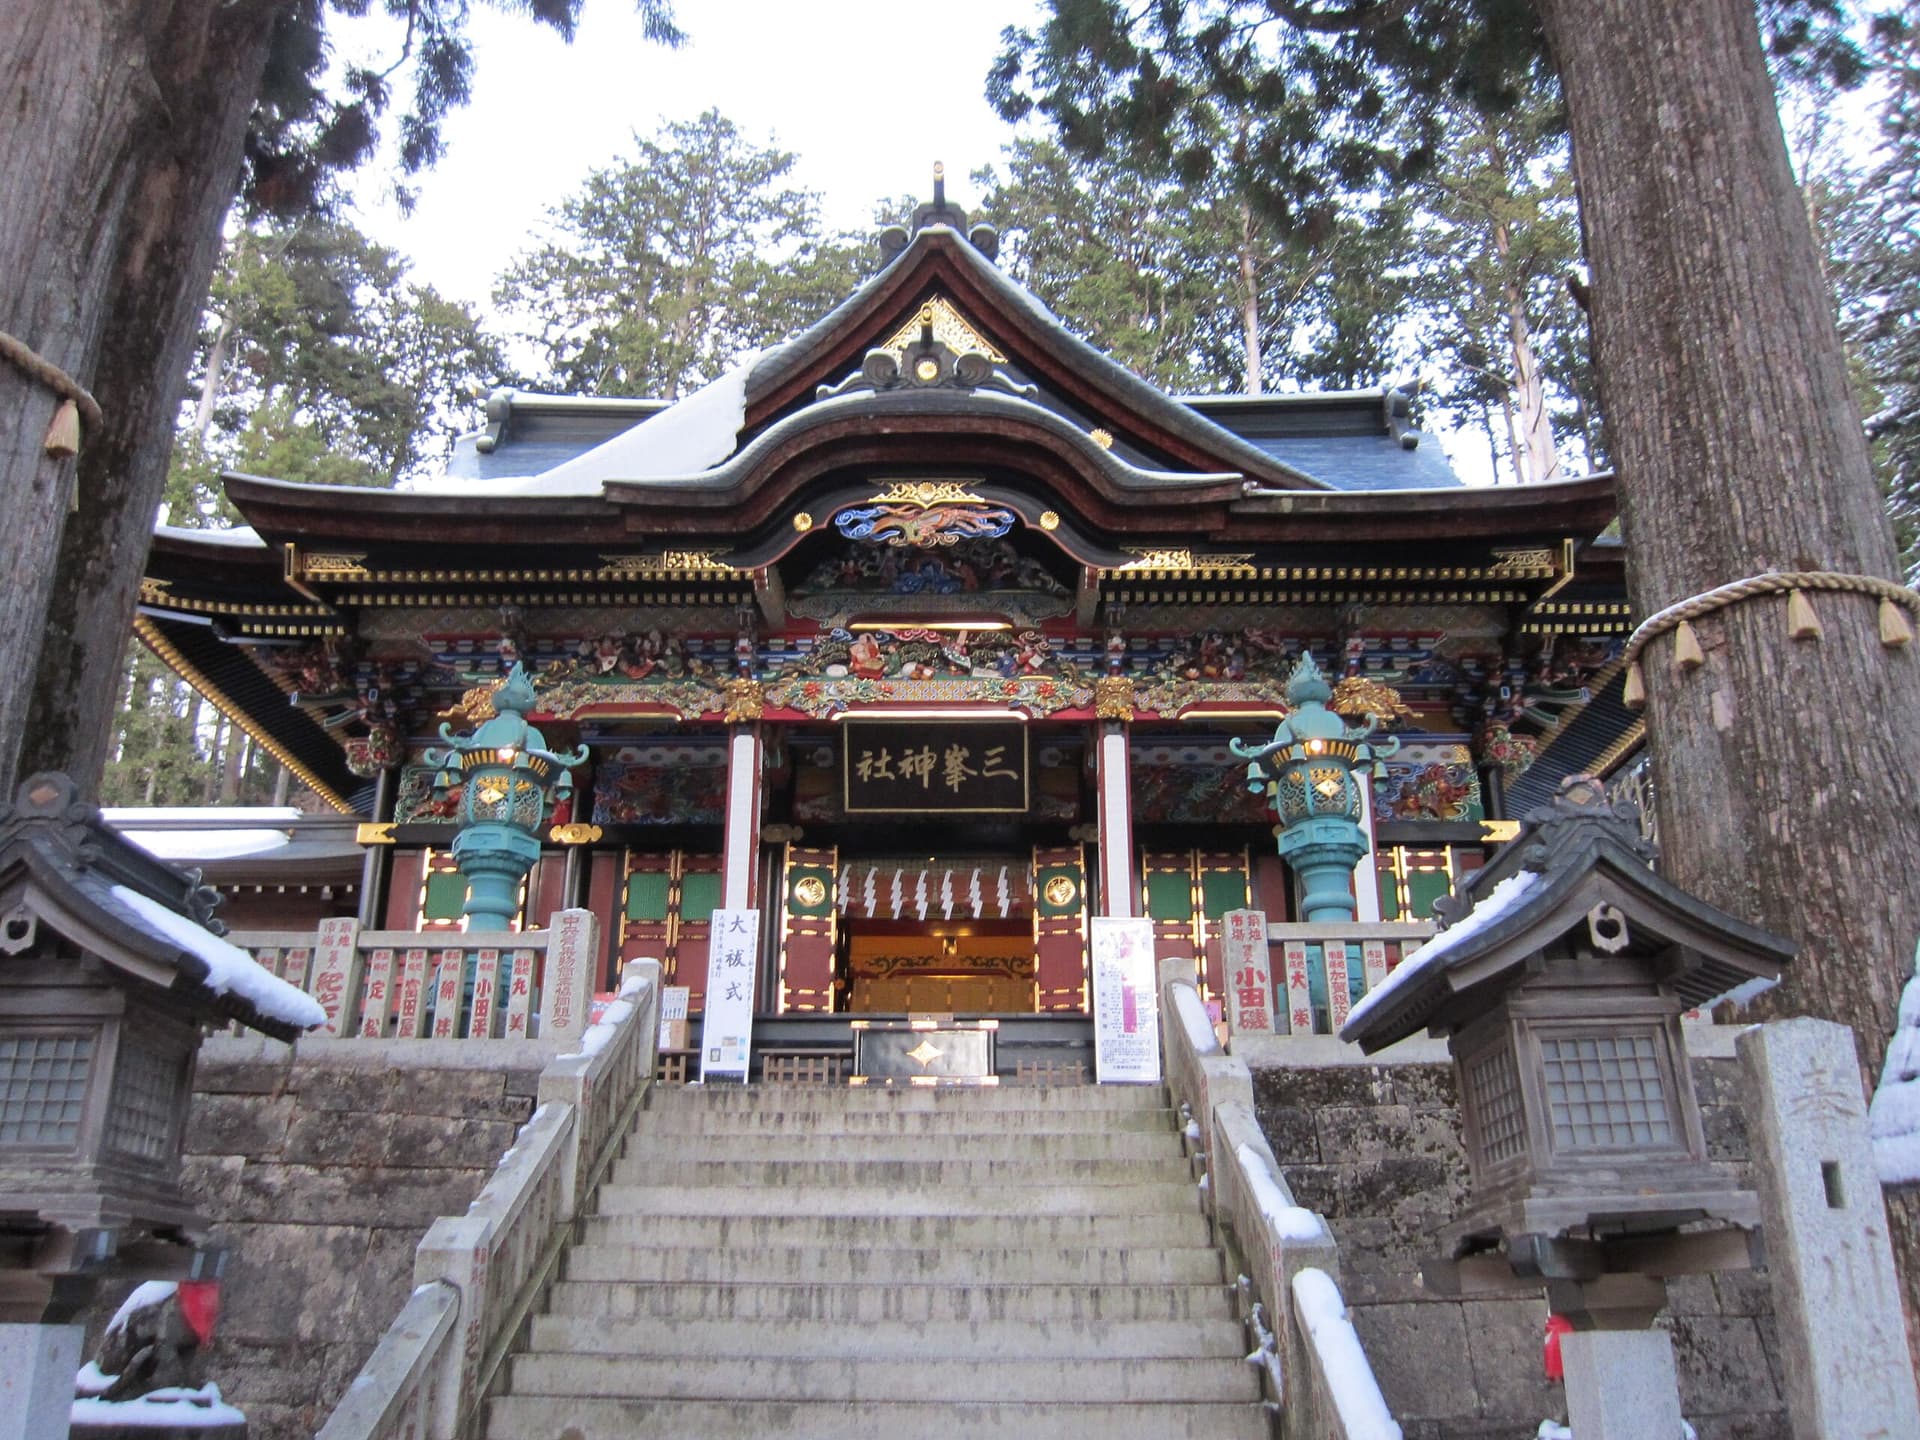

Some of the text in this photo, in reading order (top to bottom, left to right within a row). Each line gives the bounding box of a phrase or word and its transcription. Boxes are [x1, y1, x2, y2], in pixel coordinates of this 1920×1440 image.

[855, 743, 1019, 794] 三峯神社
[725, 914, 749, 1002] 大祓式
[472, 977, 492, 1037] 小田平
[1235, 966, 1269, 1030] 小田磯
[1788, 1054, 1862, 1134] 奉
[1822, 1225, 1906, 1440] 川崎
